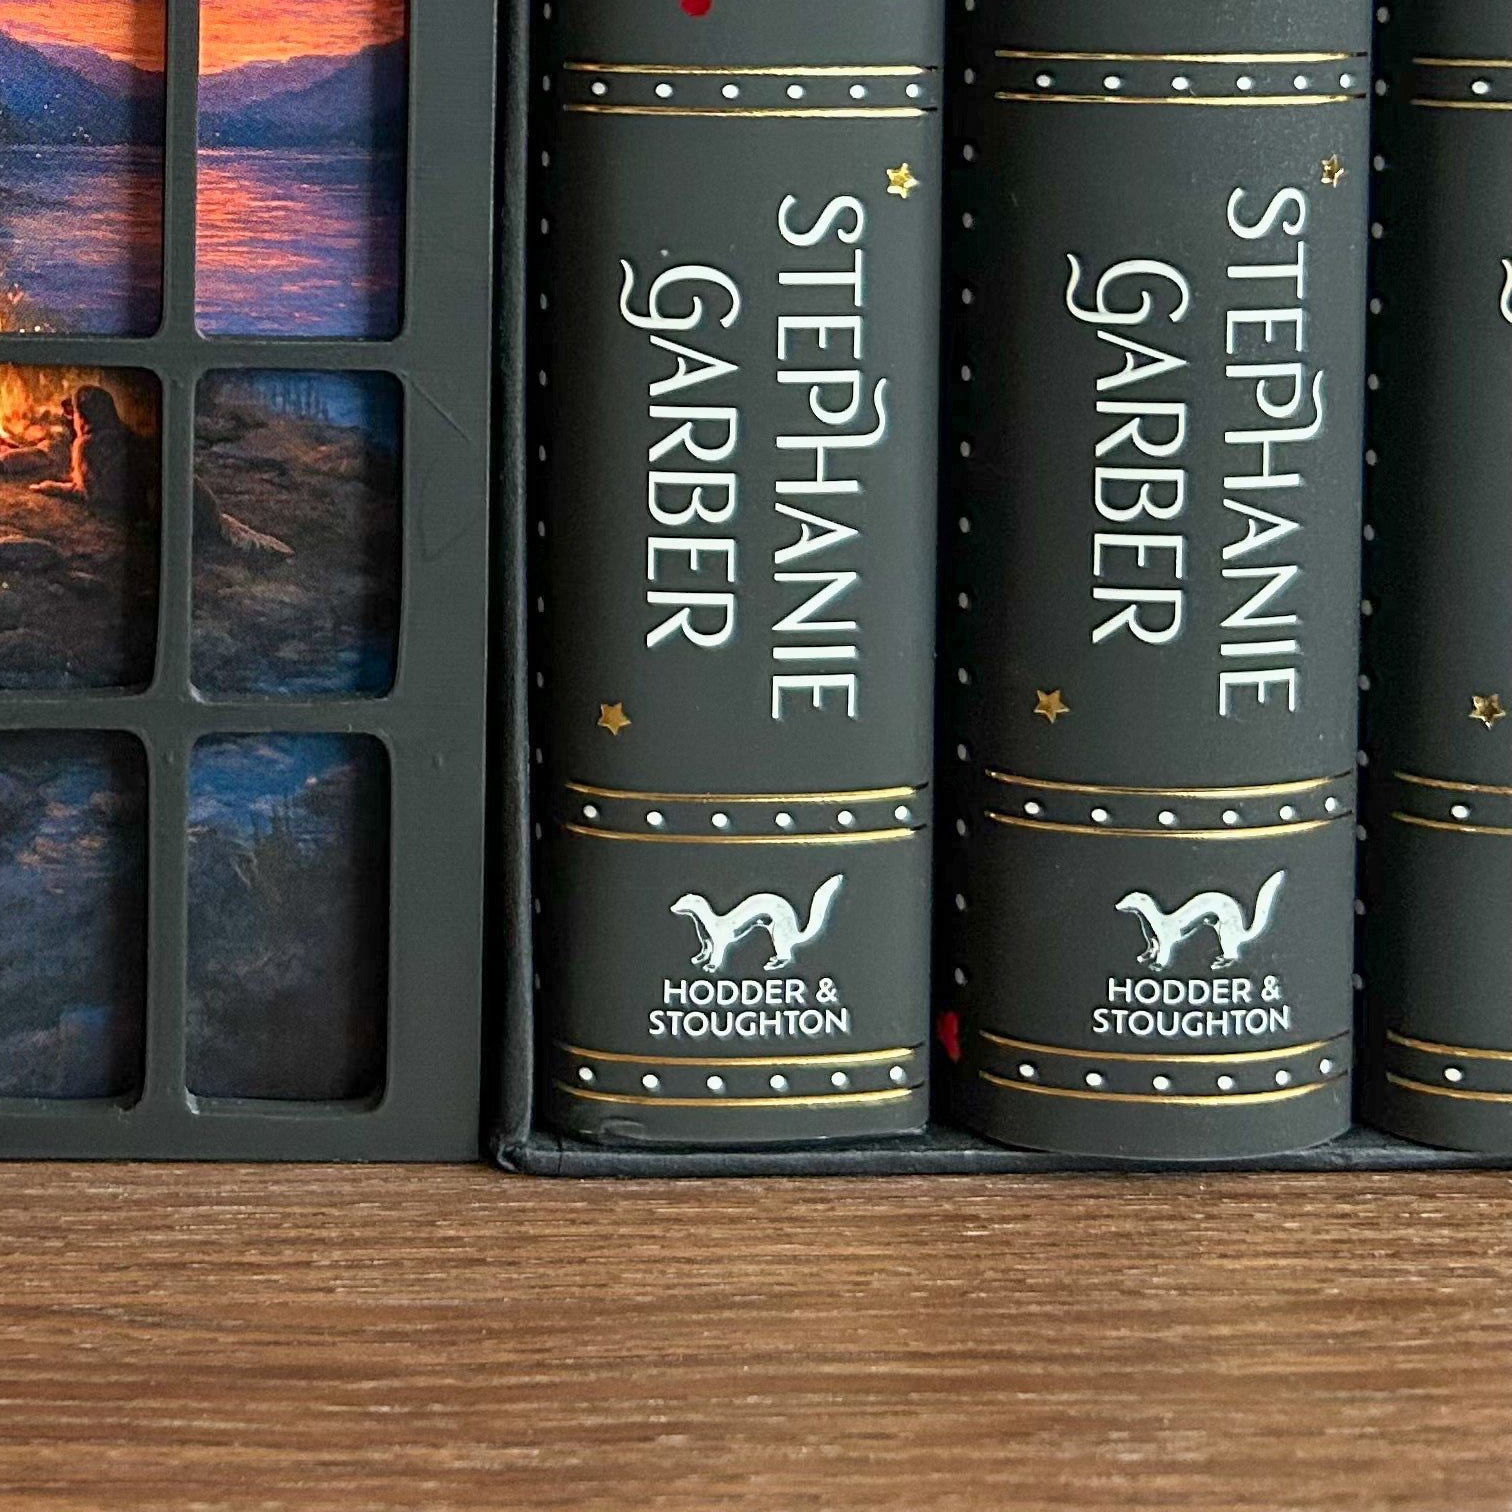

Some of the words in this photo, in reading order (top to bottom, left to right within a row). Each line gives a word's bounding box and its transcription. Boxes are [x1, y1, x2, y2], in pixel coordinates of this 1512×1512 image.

[619, 258, 742, 649] GARBER
[771, 194, 889, 720] STEPHANIE
[1065, 252, 1190, 645] GARBER
[1217, 186, 1324, 717] STEPHANIE
[648, 1006, 850, 1039] STOUGHTON
[662, 977, 809, 1007] HODDER
[814, 976, 839, 1005] &
[1092, 1004, 1292, 1038] STOUGHTON
[1107, 976, 1252, 1005] HODDER
[1259, 974, 1283, 1002] &
